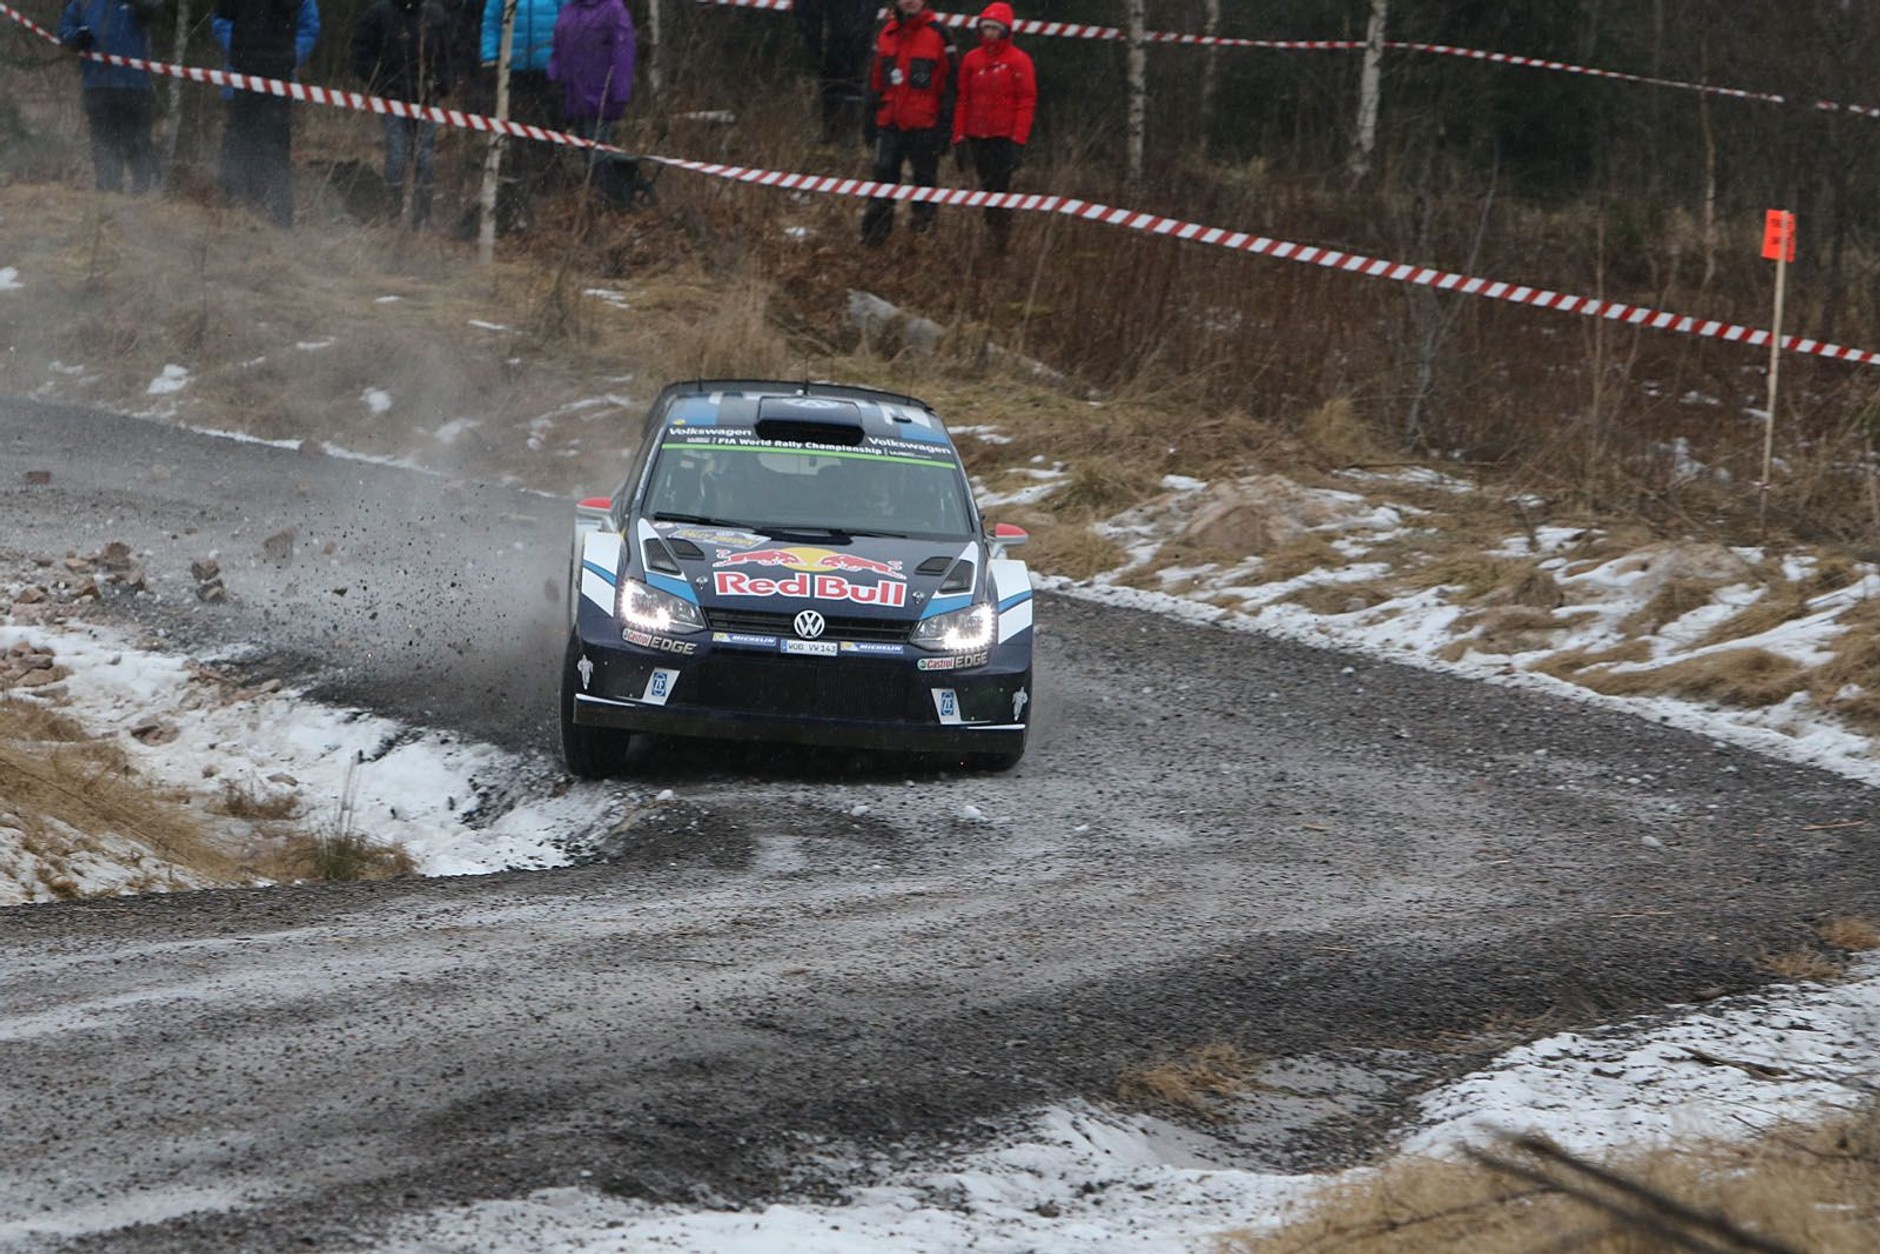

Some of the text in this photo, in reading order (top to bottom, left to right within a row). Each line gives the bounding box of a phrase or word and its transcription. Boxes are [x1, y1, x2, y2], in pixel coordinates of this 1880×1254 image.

[669, 427, 752, 437] Volkswagen
[718, 437, 737, 445] FIA
[739, 438, 772, 447] World
[774, 440, 802, 449] Rally
[805, 441, 882, 455] Championship
[868, 436, 951, 455] Volkswagen
[713, 571, 907, 607] Red Bull
[650, 636, 697, 655] EDGE
[732, 635, 775, 645] MICHELIN
[858, 644, 902, 652] MICHELIN
[927, 651, 988, 669] Castrol EDGE
